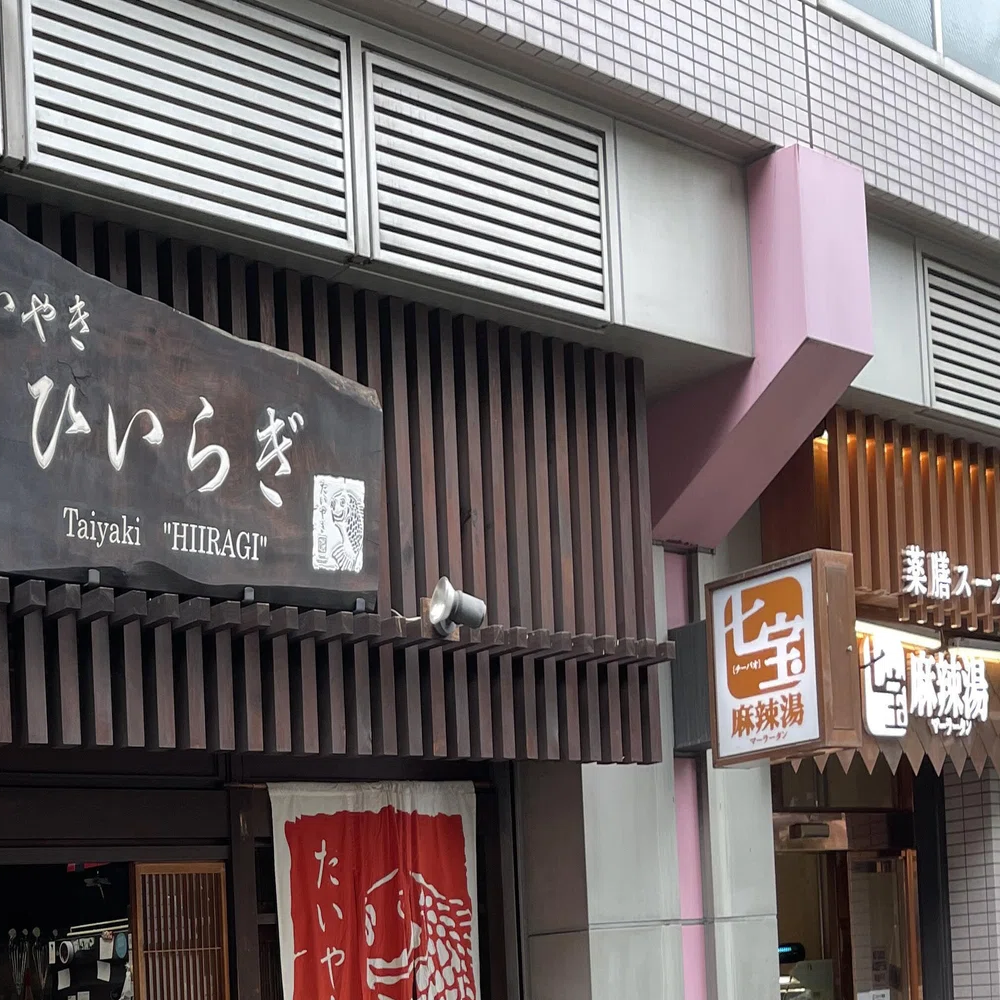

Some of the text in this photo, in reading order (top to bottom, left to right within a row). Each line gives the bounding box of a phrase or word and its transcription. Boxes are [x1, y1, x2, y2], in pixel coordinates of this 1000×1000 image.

[27, 374, 305, 507] ひいらぎ
[63, 506, 268, 561] Taiyaki "HIIRAGI"
[731, 692, 804, 739] 麻辣湯
[910, 650, 989, 723] 麻辣湯
